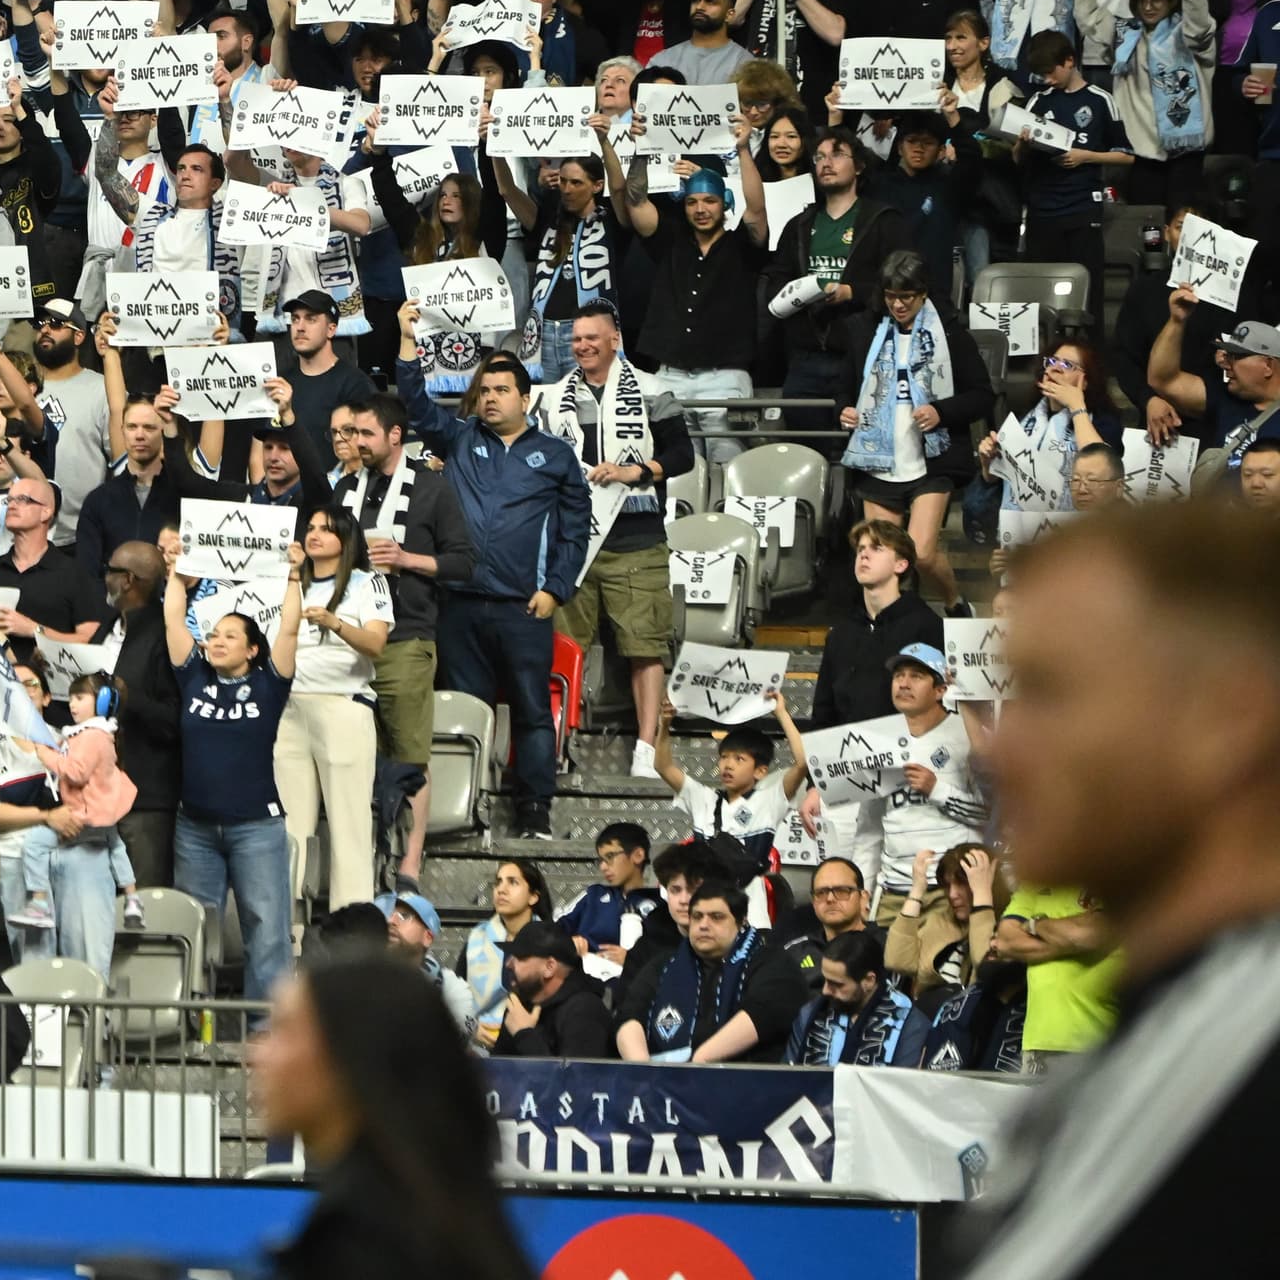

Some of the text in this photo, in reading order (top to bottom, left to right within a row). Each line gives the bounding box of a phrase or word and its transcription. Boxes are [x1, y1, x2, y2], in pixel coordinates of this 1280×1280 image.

[854, 67, 878, 80] SAVE
[896, 66, 924, 80] CAPS
[395, 103, 419, 117] SAVE
[437, 104, 463, 117] CAPS
[652, 113, 675, 126] SAVE
[693, 113, 720, 126] CAPS
[424, 292, 448, 307] SAVE
[465, 286, 493, 302] CAPS
[126, 302, 152, 316] SAVE
[171, 302, 199, 316] CAPS
[616, 423, 643, 439] FC
[197, 532, 224, 547] SAVE
[243, 536, 272, 551] CAPS
[189, 698, 260, 720] TELUS
[486, 1088, 680, 1126] OASTAL
